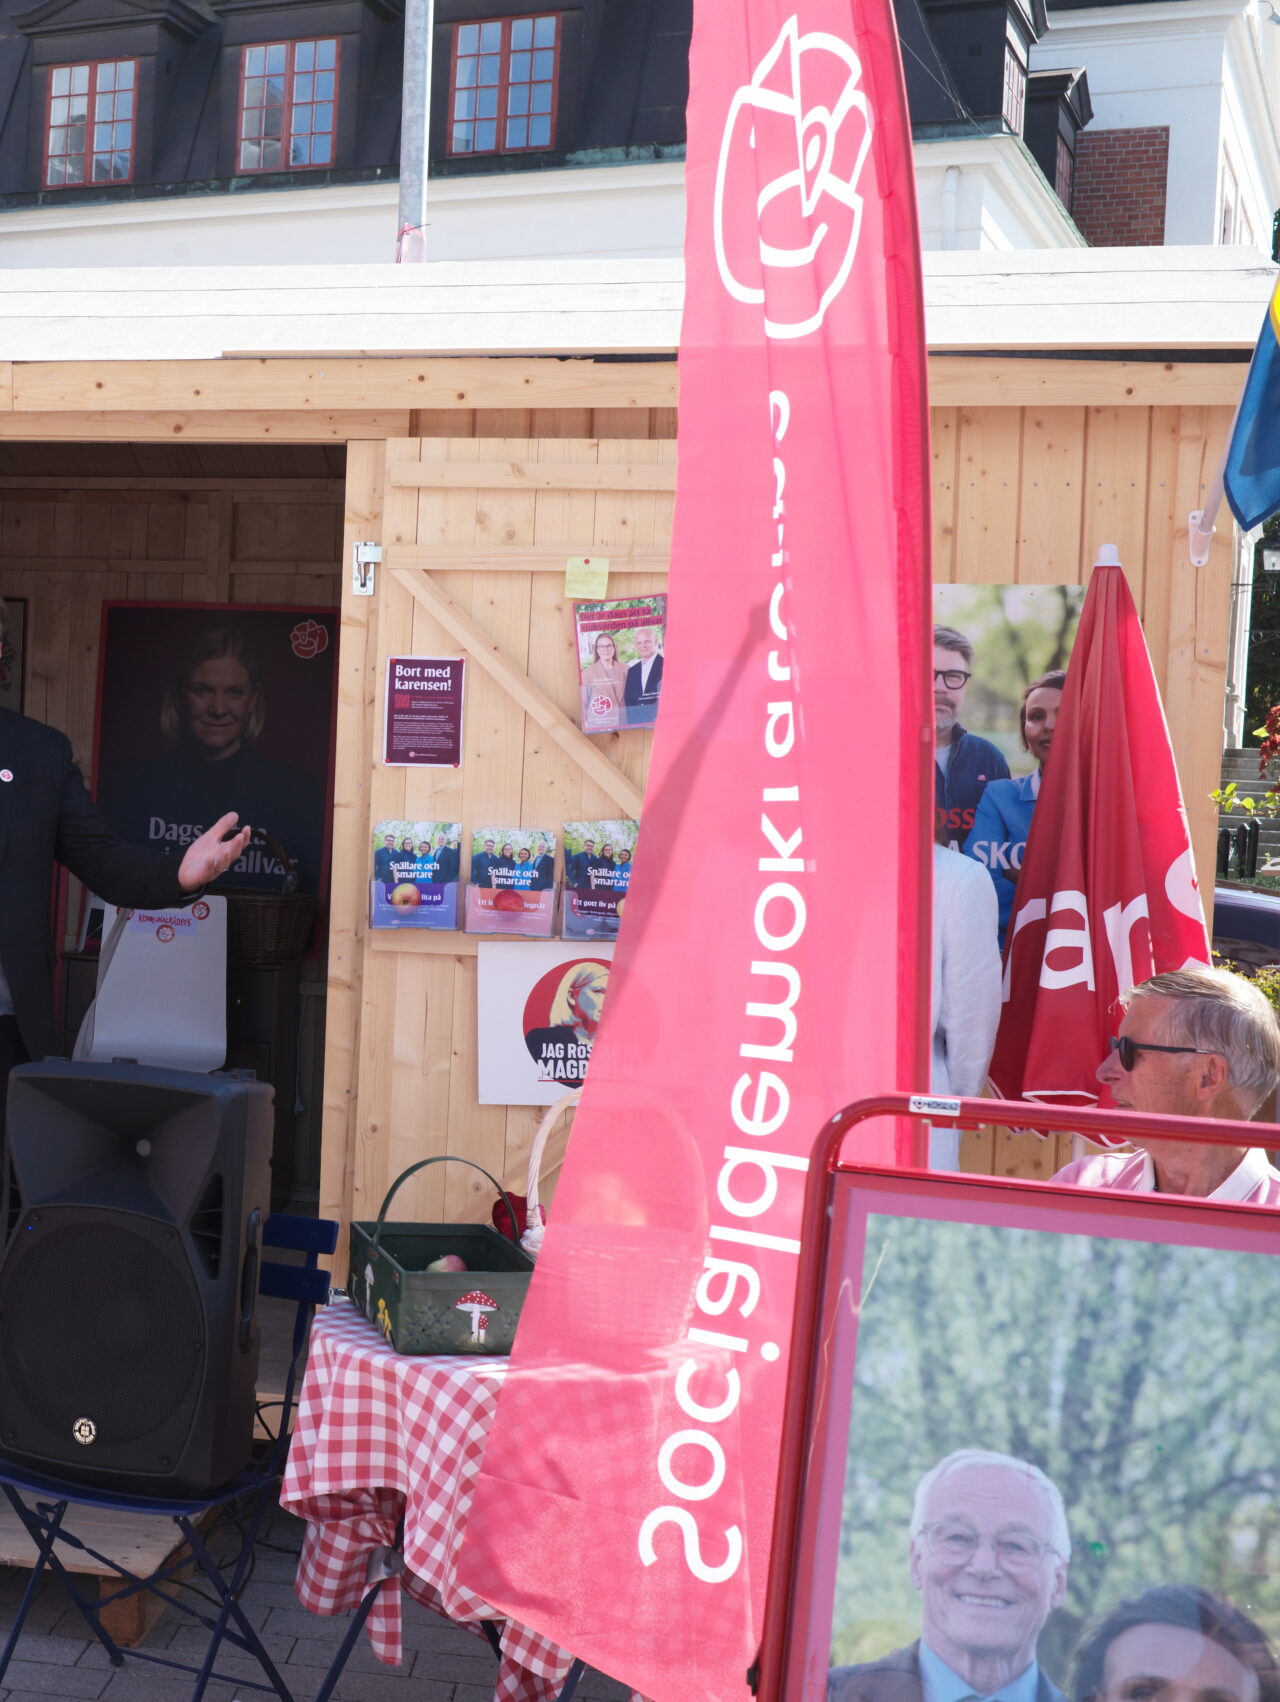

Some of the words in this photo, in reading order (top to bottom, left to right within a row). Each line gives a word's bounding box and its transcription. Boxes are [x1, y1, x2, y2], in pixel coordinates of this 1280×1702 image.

[607, 610, 628, 620] dags
[395, 664, 422, 677] Bort
[424, 666, 451, 678] med
[394, 678, 452, 691] karensen!
[389, 861, 423, 871] Snällare
[424, 862, 440, 870] och
[488, 866, 521, 877] Snällare
[523, 868, 538, 877] och
[396, 870, 434, 879] smartare
[587, 866, 620, 878] Snällare
[494, 876, 532, 886] smartare
[541, 1042, 565, 1058] JAG
